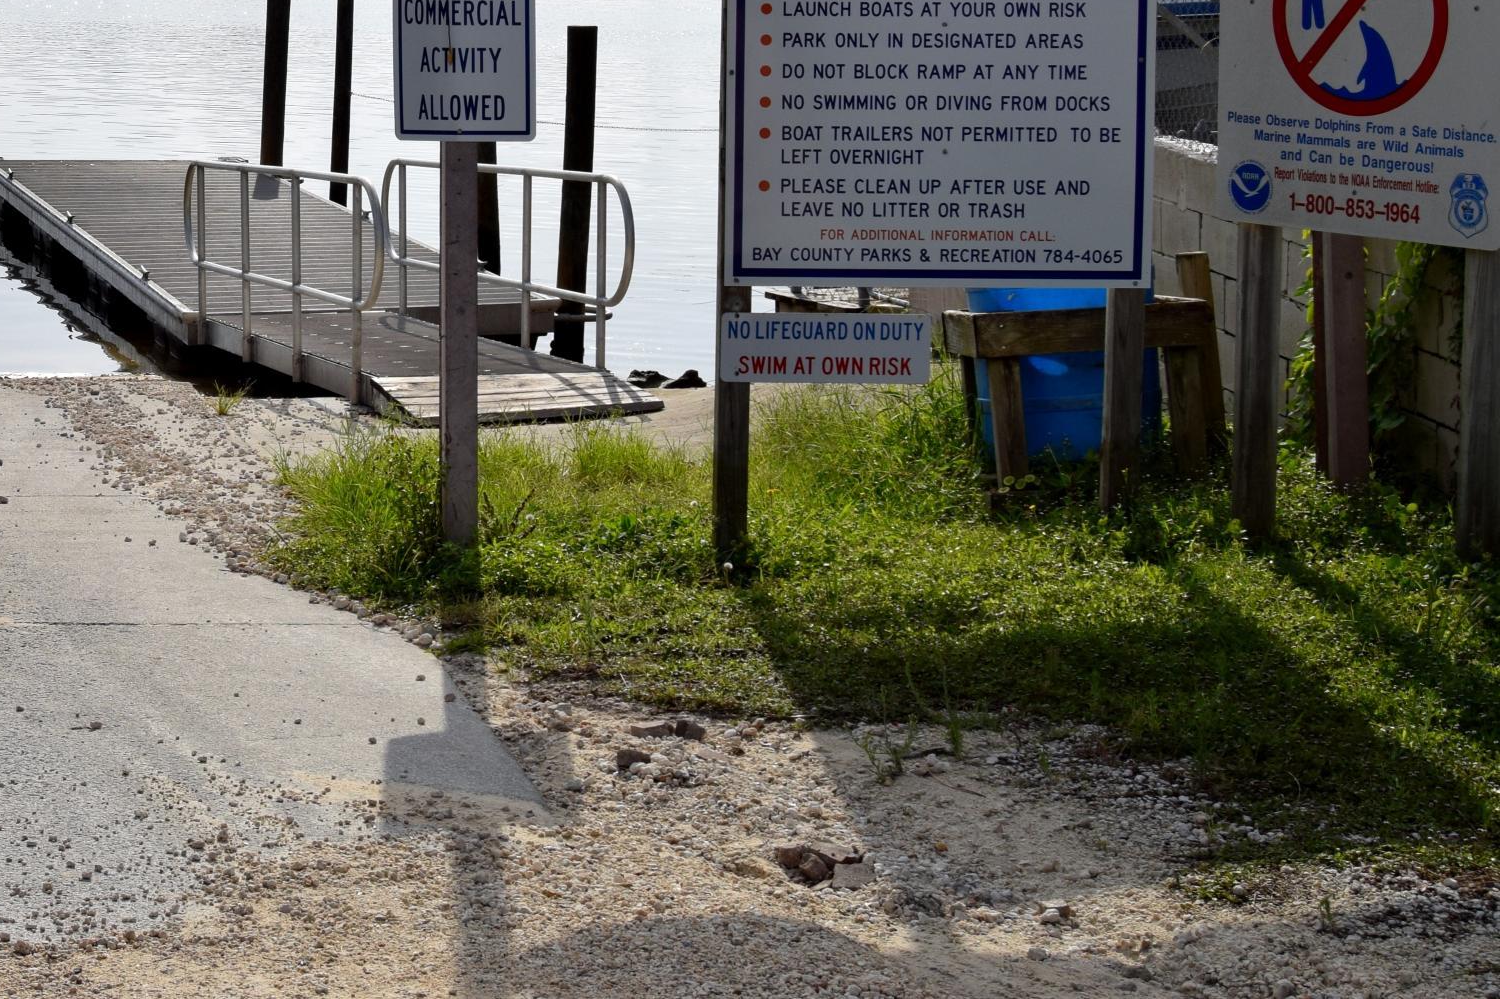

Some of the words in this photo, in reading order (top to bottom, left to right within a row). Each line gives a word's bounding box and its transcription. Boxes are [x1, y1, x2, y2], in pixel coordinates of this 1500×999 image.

[783, 2, 851, 16] LAUNCH
[860, 2, 913, 17] BOATS
[921, 2, 941, 16] AT
[950, 2, 995, 17] YOUR
[1004, 2, 1040, 17] OWN
[1049, 3, 1086, 17] RISK
[783, 33, 825, 47] PARK
[836, 33, 879, 48] ONLY
[888, 33, 902, 48] IN
[912, 33, 1016, 48] DESIGNATED
[1026, 34, 1083, 48] AREAS
[420, 47, 501, 73] ACTIVITY
[783, 64, 804, 78] DO
[814, 64, 845, 79] NOT
[854, 64, 908, 79] BLOCK
[918, 65, 965, 79] RAMP
[973, 65, 994, 79] AT
[1003, 65, 1038, 79] ANY
[1048, 65, 1087, 80] TIME
[419, 94, 505, 120] ALLOWED
[782, 95, 804, 109] NO
[813, 95, 896, 110] SWIMMING
[906, 95, 927, 110] OR
[937, 96, 991, 110] DIVING
[1001, 96, 1046, 111] FROM
[1056, 96, 1110, 111] DOCKS
[782, 126, 823, 140] BOAT
[831, 126, 913, 141] TRAILERS
[922, 127, 953, 141] NOT
[962, 127, 1057, 142] PERMITTED
[1071, 128, 1091, 142] TO
[1100, 128, 1120, 142] BE
[1228, 111, 1261, 124] Please
[1266, 114, 1309, 128] Observe
[1315, 118, 1360, 133] Dolphins
[1366, 122, 1393, 135] From
[1400, 127, 1405, 136] a
[1412, 125, 1437, 138] Safe
[1443, 128, 1496, 143] Distance.
[1254, 129, 1291, 143] Marine
[1297, 133, 1350, 148] Mammals
[1357, 141, 1376, 150] are
[1383, 140, 1408, 153] Wild
[1415, 143, 1464, 157] Animals
[782, 149, 822, 164] LEFT
[830, 149, 924, 164] OVERNIGHT
[1281, 149, 1301, 161] and
[1309, 150, 1332, 164] Can
[1340, 153, 1354, 166] be
[1362, 155, 1434, 174] Dangerous!
[781, 179, 846, 193] PLEASE
[855, 179, 910, 194] CLEAN
[919, 180, 941, 194] UP
[950, 180, 1004, 194] AFTER
[1014, 180, 1046, 195] USE
[1055, 181, 1090, 195] AND
[1275, 166, 1294, 182] Report
[1298, 168, 1327, 183] Violations
[1330, 173, 1336, 184] to
[1339, 174, 1348, 185] the
[1352, 174, 1370, 187] NOAA
[1373, 176, 1413, 191] Enforcement
[1416, 180, 1439, 194] Hotline:
[782, 202, 833, 216] LEAVE
[842, 202, 863, 217] NO
[873, 202, 929, 217] LITTER
[939, 203, 959, 217] OR
[968, 203, 1024, 218] TRASH
[1289, 191, 1420, 224] 1-800-853-1964
[821, 229, 844, 240] FOR
[851, 230, 925, 240] ADDITIONAL
[931, 230, 1013, 241] INFORMATION
[1020, 229, 1056, 242] CALL:
[753, 248, 782, 261] BAY
[791, 248, 853, 261] COUNTY
[861, 248, 911, 262] PARKS
[920, 249, 930, 262] &
[940, 249, 1035, 263] RECREATION
[1044, 250, 1122, 263] 784-4065
[728, 321, 750, 339] NO
[756, 321, 847, 340] LIFEGUARD
[854, 322, 875, 340] ON
[880, 323, 923, 340] DUTY
[739, 356, 787, 375] SWIM
[793, 357, 815, 374] AT
[822, 357, 863, 375] OWN
[870, 357, 911, 375] RISK
